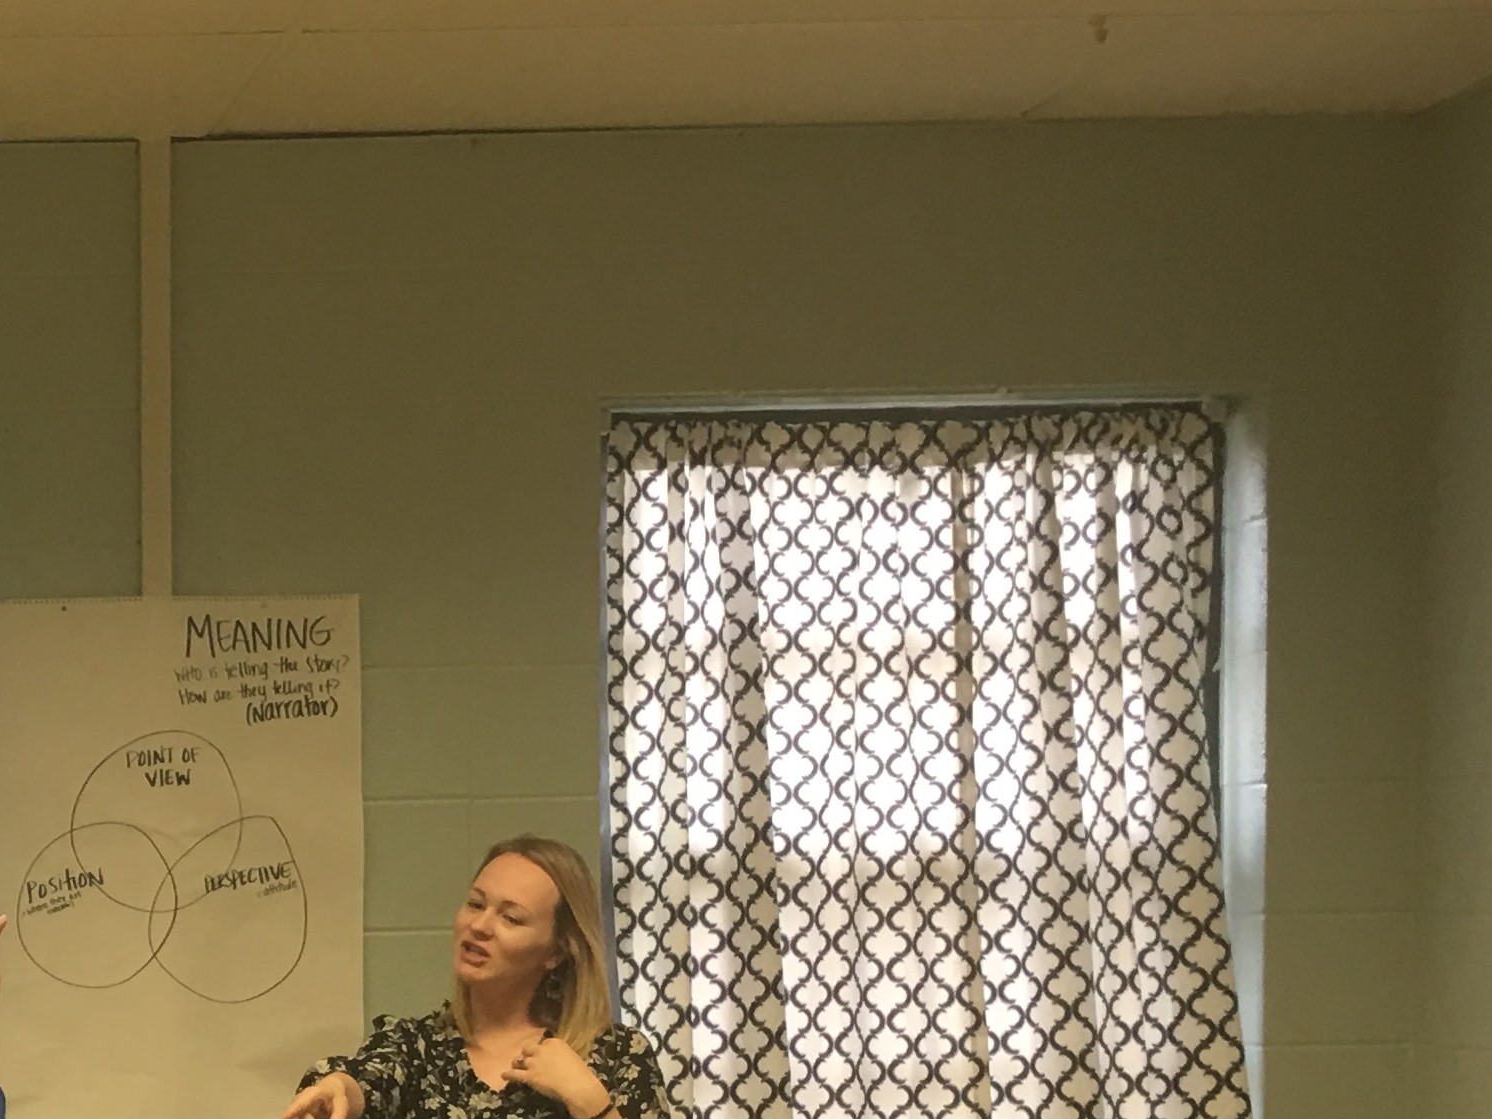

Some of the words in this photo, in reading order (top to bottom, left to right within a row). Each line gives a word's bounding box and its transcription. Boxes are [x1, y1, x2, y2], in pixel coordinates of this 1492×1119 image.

[185, 614, 335, 658] MEANING
[209, 665, 218, 679] is
[225, 661, 268, 680] telling
[273, 656, 298, 674] the
[213, 689, 232, 702] are
[237, 683, 267, 702] they
[273, 680, 314, 698] telling
[126, 745, 173, 768] POINT
[181, 747, 200, 763] OF
[144, 768, 191, 787] VIEW
[204, 861, 293, 894] PERSPECTIVE
